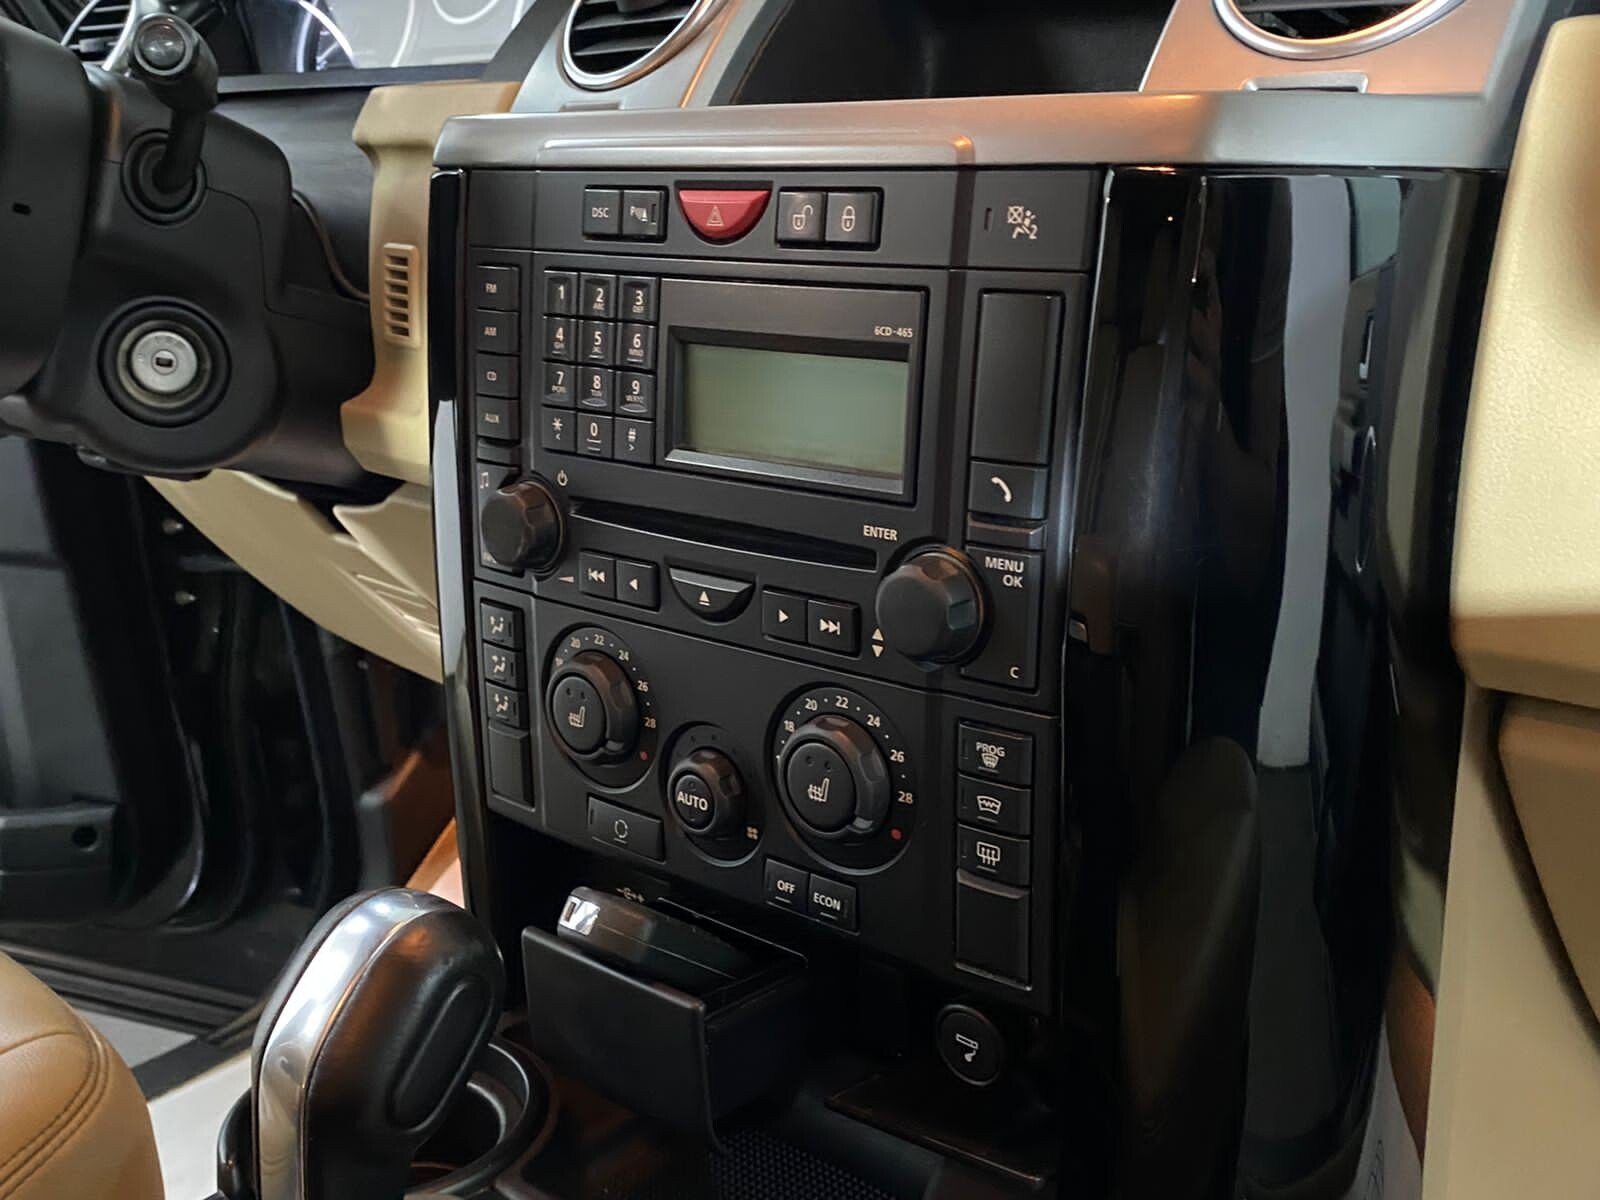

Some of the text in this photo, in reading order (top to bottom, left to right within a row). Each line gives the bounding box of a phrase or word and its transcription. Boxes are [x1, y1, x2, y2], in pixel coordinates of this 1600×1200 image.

[592, 207, 609, 218] DSC
[558, 285, 565, 300] 1
[595, 287, 605, 303] 2
[635, 290, 644, 306] 3
[555, 327, 564, 341] 4
[594, 331, 602, 346] 5
[632, 333, 642, 349] 6
[556, 371, 565, 385] 7
[593, 375, 601, 389] 8
[631, 380, 640, 395] 9
[590, 422, 599, 437] 0
[863, 525, 897, 541] ENTER
[985, 556, 1024, 573] MENU
[1002, 575, 1023, 588] OK
[570, 637, 581, 649] 20
[594, 634, 605, 646] 22
[618, 650, 630, 661] 24
[1009, 666, 1019, 679] C
[637, 680, 649, 692] 26
[805, 698, 818, 711] 20
[835, 695, 849, 709] 22
[644, 717, 656, 729] 28
[784, 720, 795, 733] 18
[867, 714, 881, 728] 24
[890, 749, 905, 763] 26
[976, 742, 1005, 758] PROG
[677, 791, 708, 811] AUTO
[898, 791, 912, 804] 28
[777, 879, 796, 894] OFF
[813, 892, 841, 911] ECON
